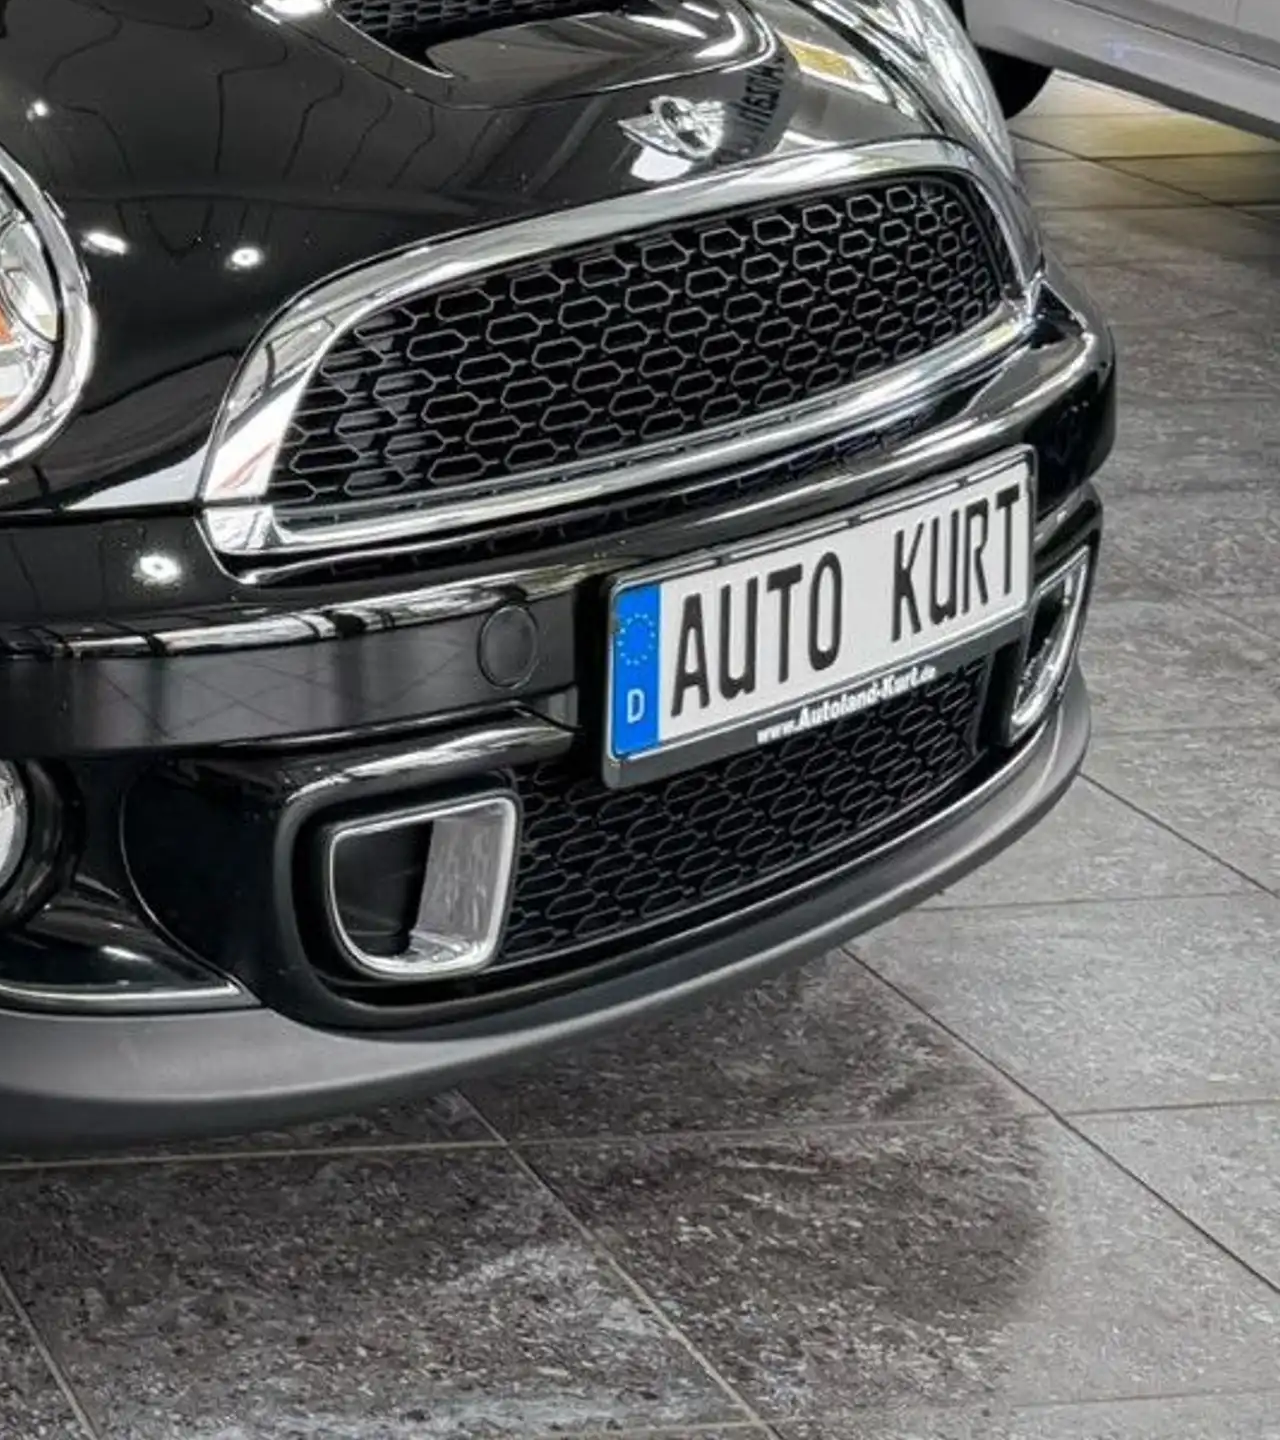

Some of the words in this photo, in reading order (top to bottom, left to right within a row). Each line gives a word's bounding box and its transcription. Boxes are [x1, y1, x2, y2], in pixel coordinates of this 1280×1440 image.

[670, 551, 843, 717] AUTO
[891, 482, 1020, 642] KURT
[626, 688, 645, 724] D
